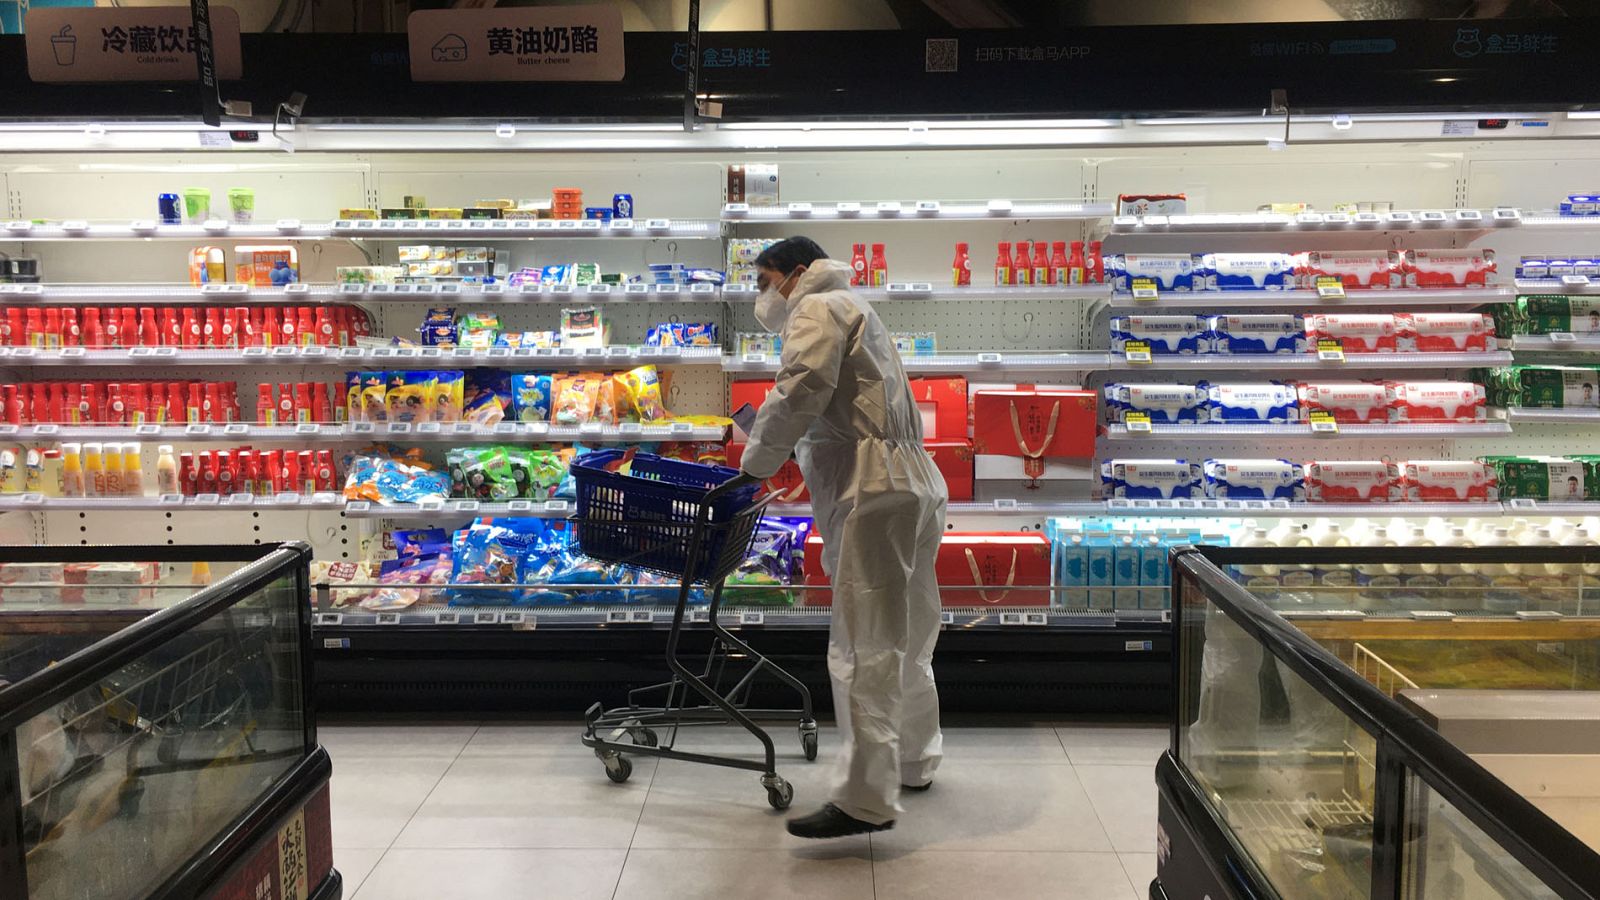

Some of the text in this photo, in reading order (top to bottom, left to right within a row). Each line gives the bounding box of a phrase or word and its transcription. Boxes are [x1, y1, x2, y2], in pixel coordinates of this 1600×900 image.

[487, 25, 598, 56] 黄油奶酪
[703, 47, 771, 68] 盒马鲜生
[975, 46, 1091, 62] 扫码下载盒马APP
